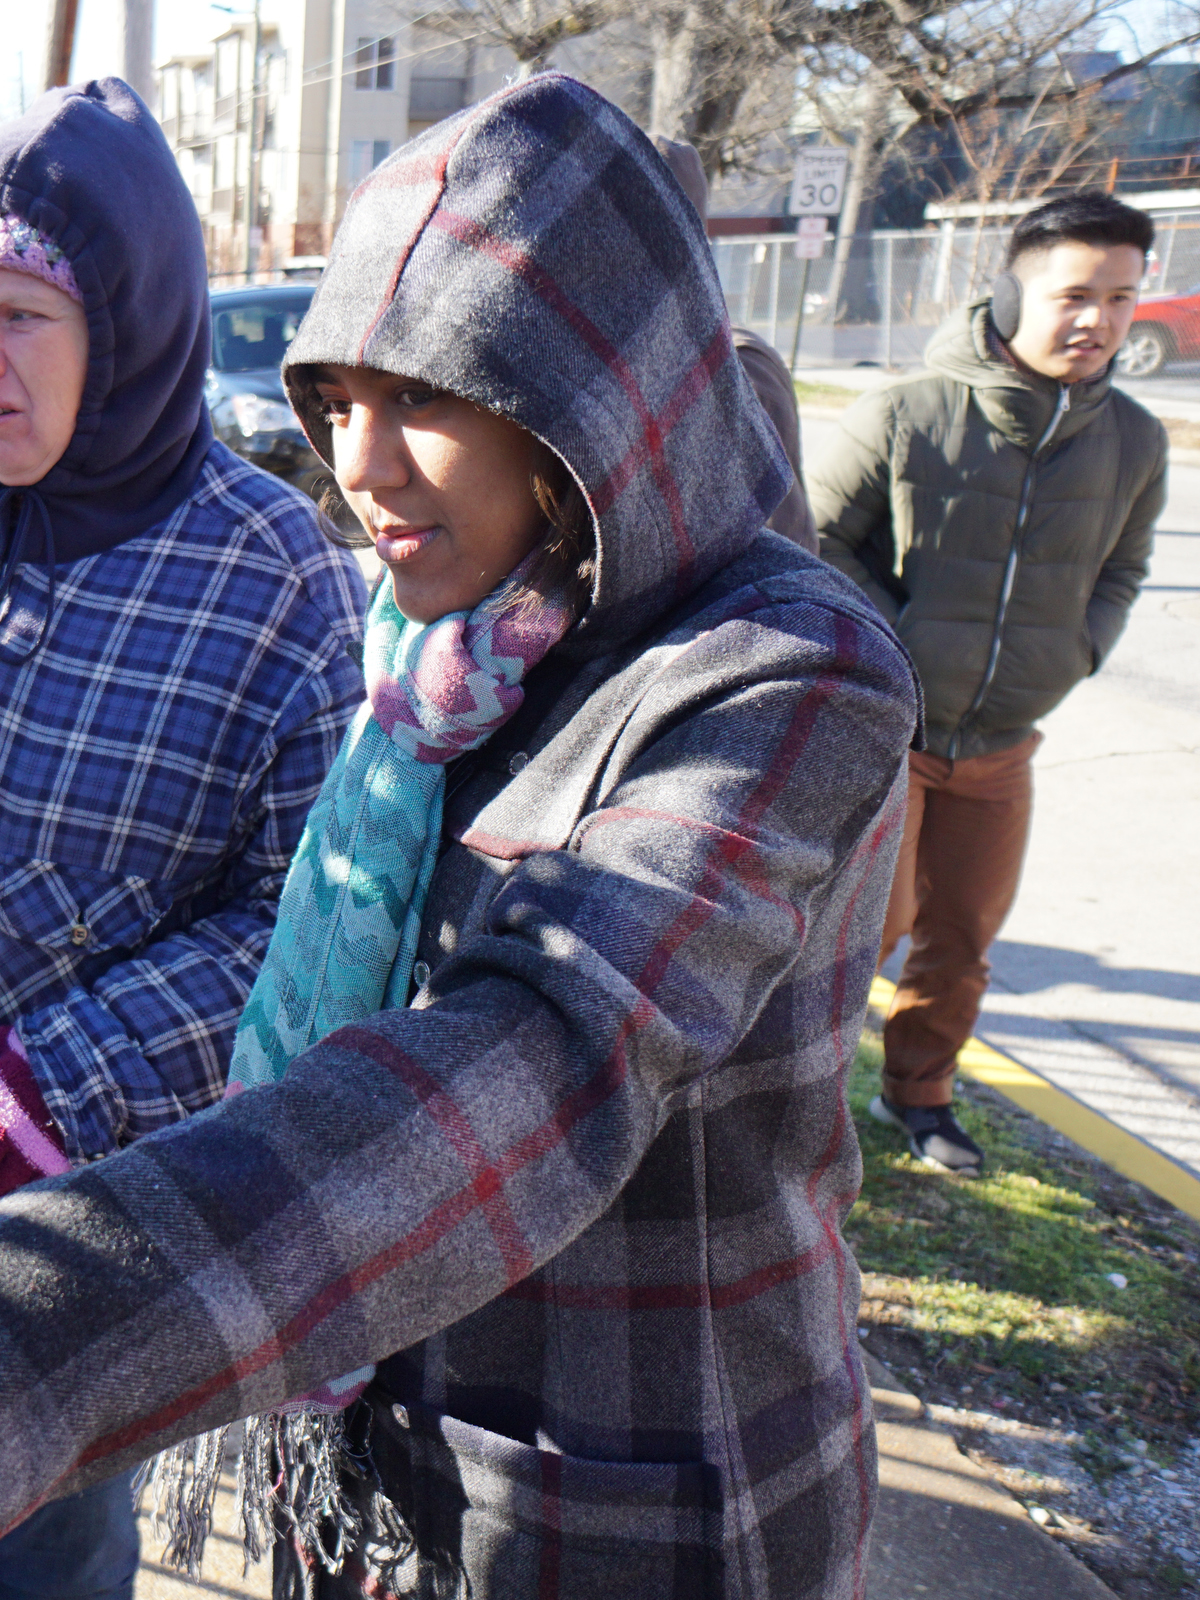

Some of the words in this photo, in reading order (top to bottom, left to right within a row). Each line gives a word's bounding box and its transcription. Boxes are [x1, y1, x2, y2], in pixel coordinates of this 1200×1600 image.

[803, 156, 846, 166] SPEED
[804, 169, 838, 180] LIMIT
[799, 183, 838, 207] 30
